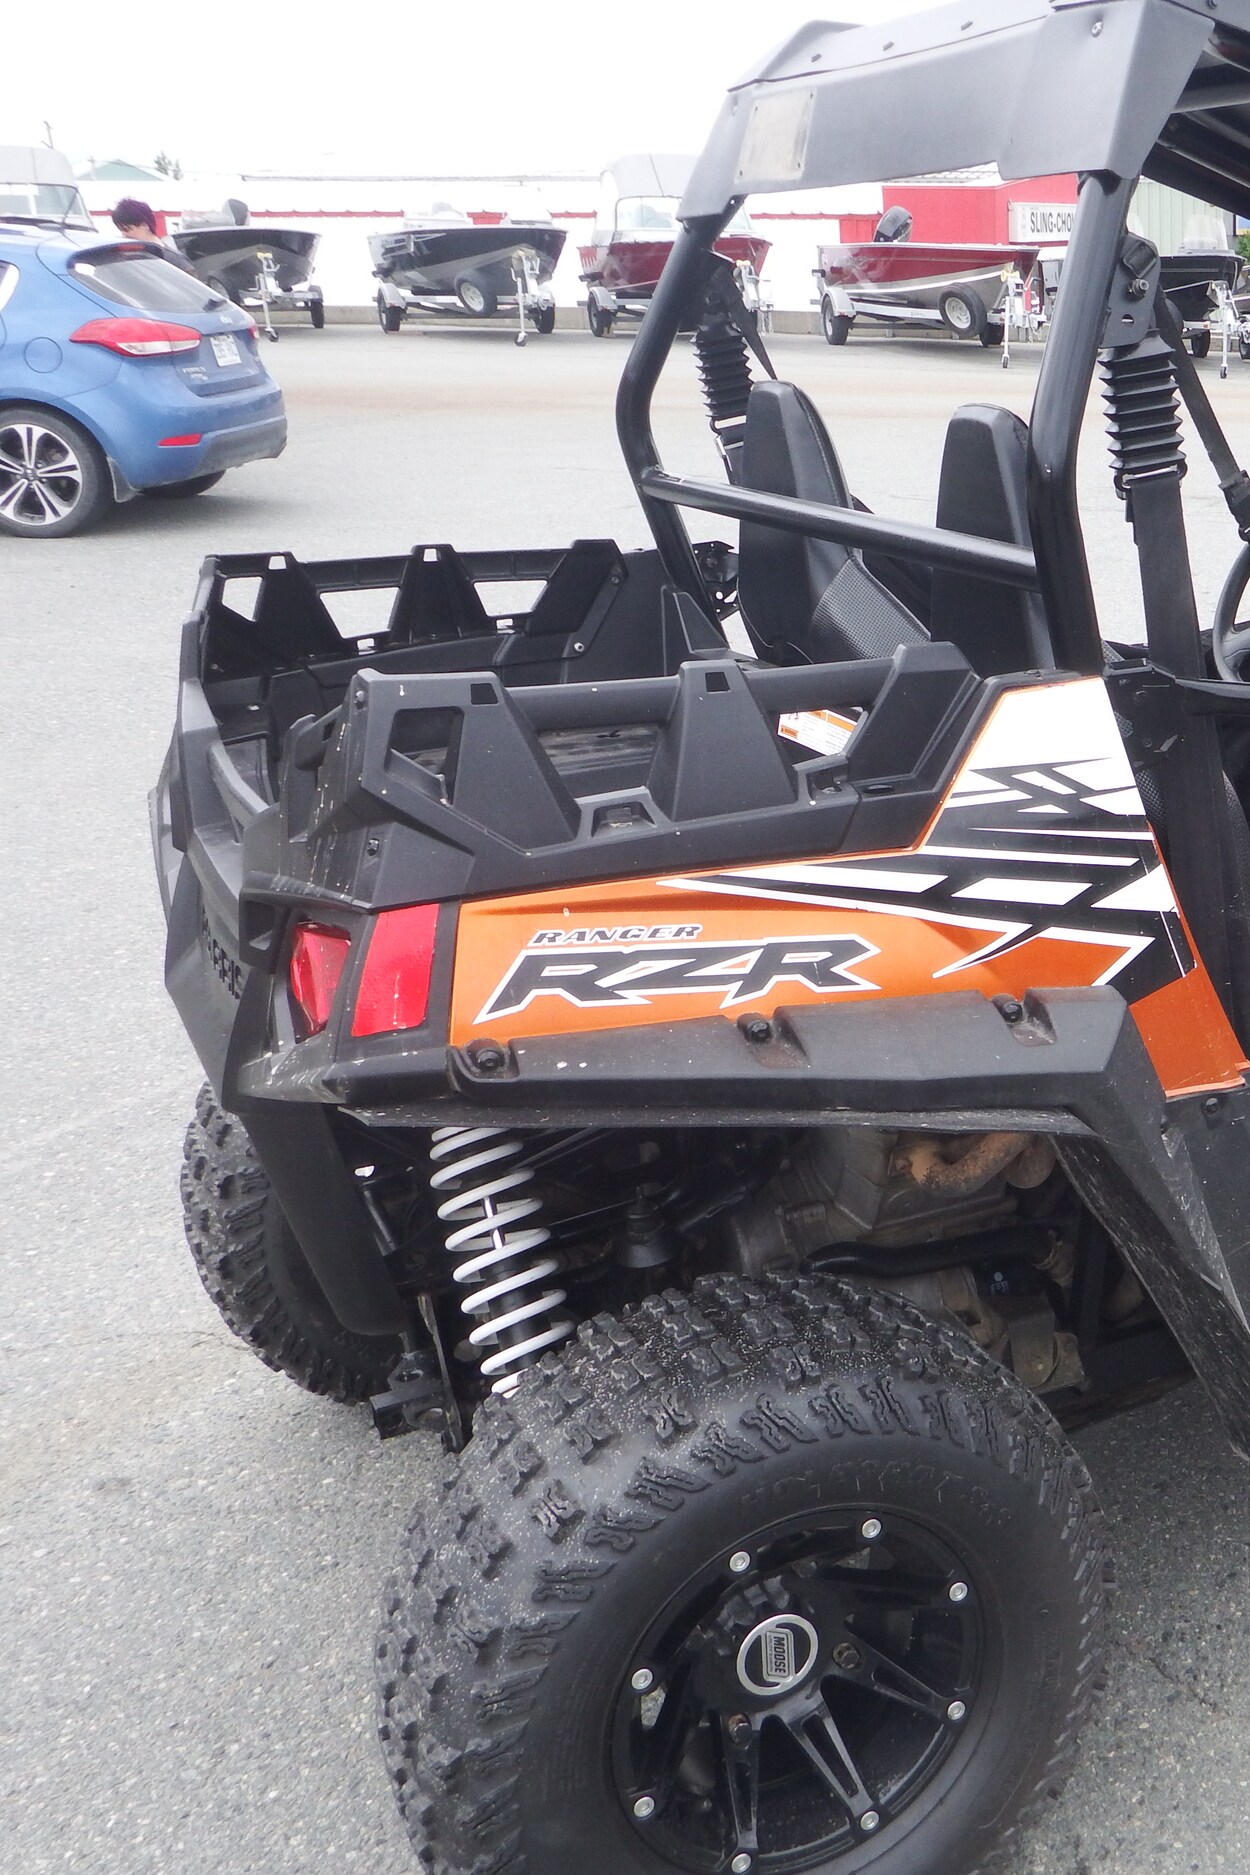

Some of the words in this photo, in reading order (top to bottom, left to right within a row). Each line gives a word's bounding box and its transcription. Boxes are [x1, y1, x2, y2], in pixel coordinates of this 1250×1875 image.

[1030, 211, 1074, 233] SLING-CHO
[530, 925, 701, 945] RANGER
[475, 935, 880, 1022] RZR
[773, 1635, 786, 1674] MOOSE
